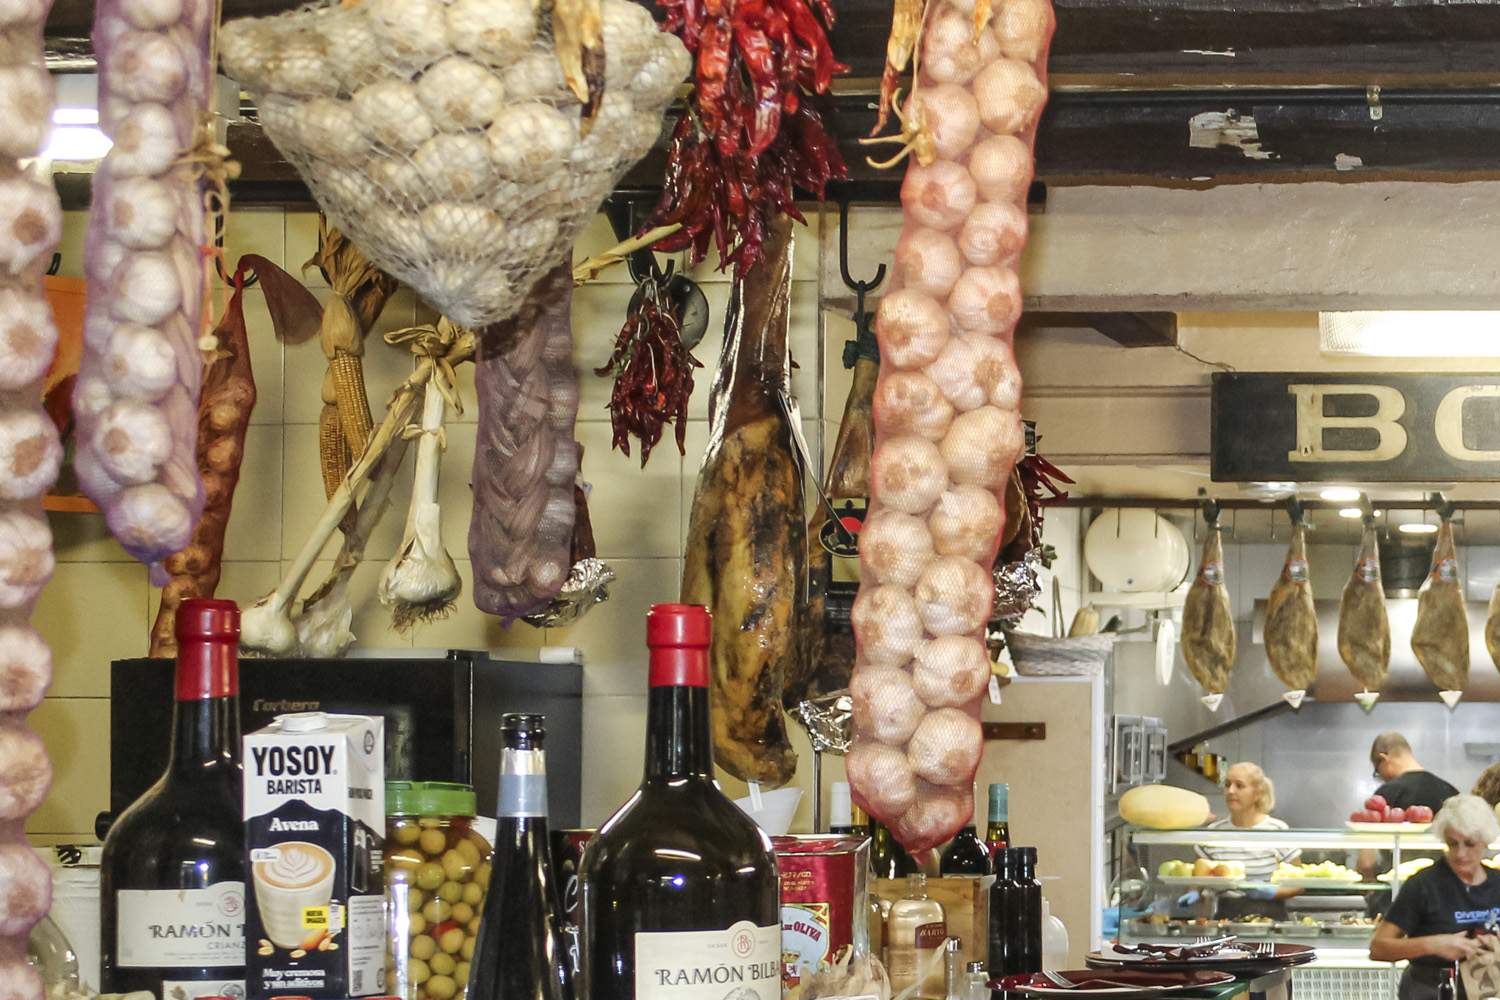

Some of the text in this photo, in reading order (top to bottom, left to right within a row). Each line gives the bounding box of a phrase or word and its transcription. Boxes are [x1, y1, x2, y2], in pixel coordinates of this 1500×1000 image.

[252, 746, 335, 776] YOSOY
[267, 778, 322, 795] BARISTA
[269, 817, 319, 832] Avena
[148, 921, 231, 938] RAMÓN
[794, 921, 822, 942] OLIVA
[208, 941, 246, 950] CRIANZ
[655, 960, 779, 985] RAMÓN BILBA
